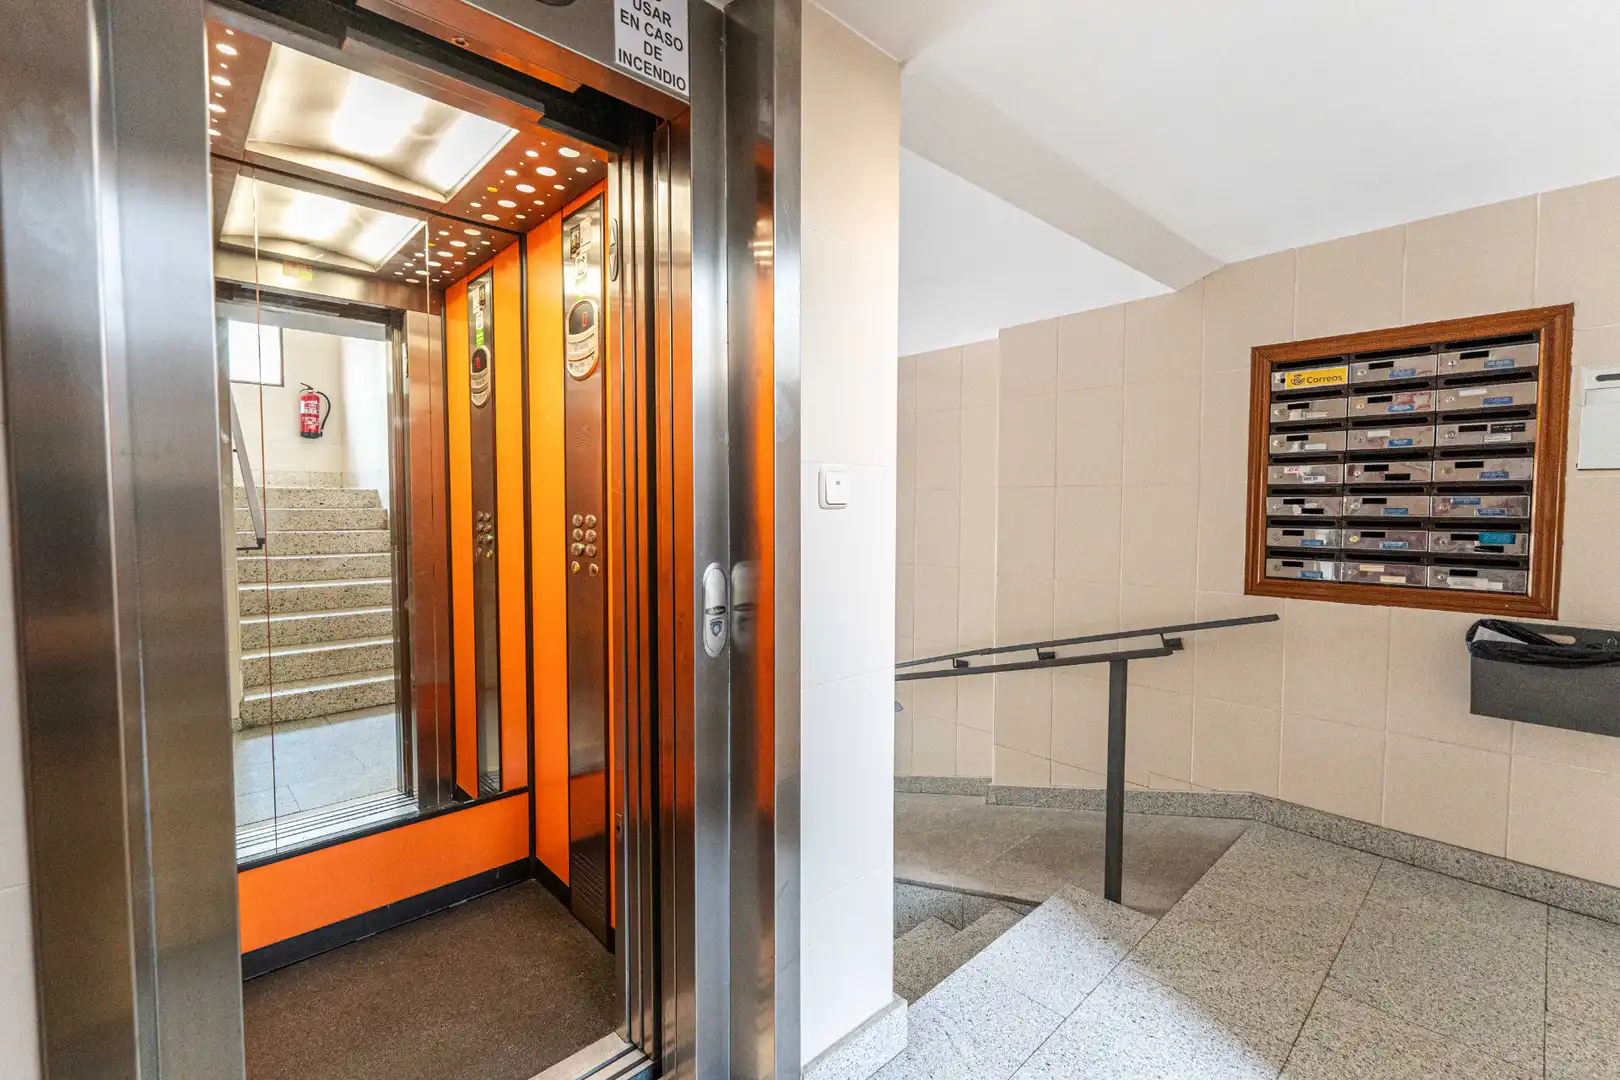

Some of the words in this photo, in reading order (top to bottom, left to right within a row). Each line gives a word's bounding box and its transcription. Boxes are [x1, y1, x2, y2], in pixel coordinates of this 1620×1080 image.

[633, 0, 672, 28] USAR
[620, 8, 640, 31] EN
[644, 22, 683, 52] CASO
[643, 41, 663, 61] DE
[618, 48, 686, 91] INCENDIO
[1306, 375, 1343, 384] Correos
